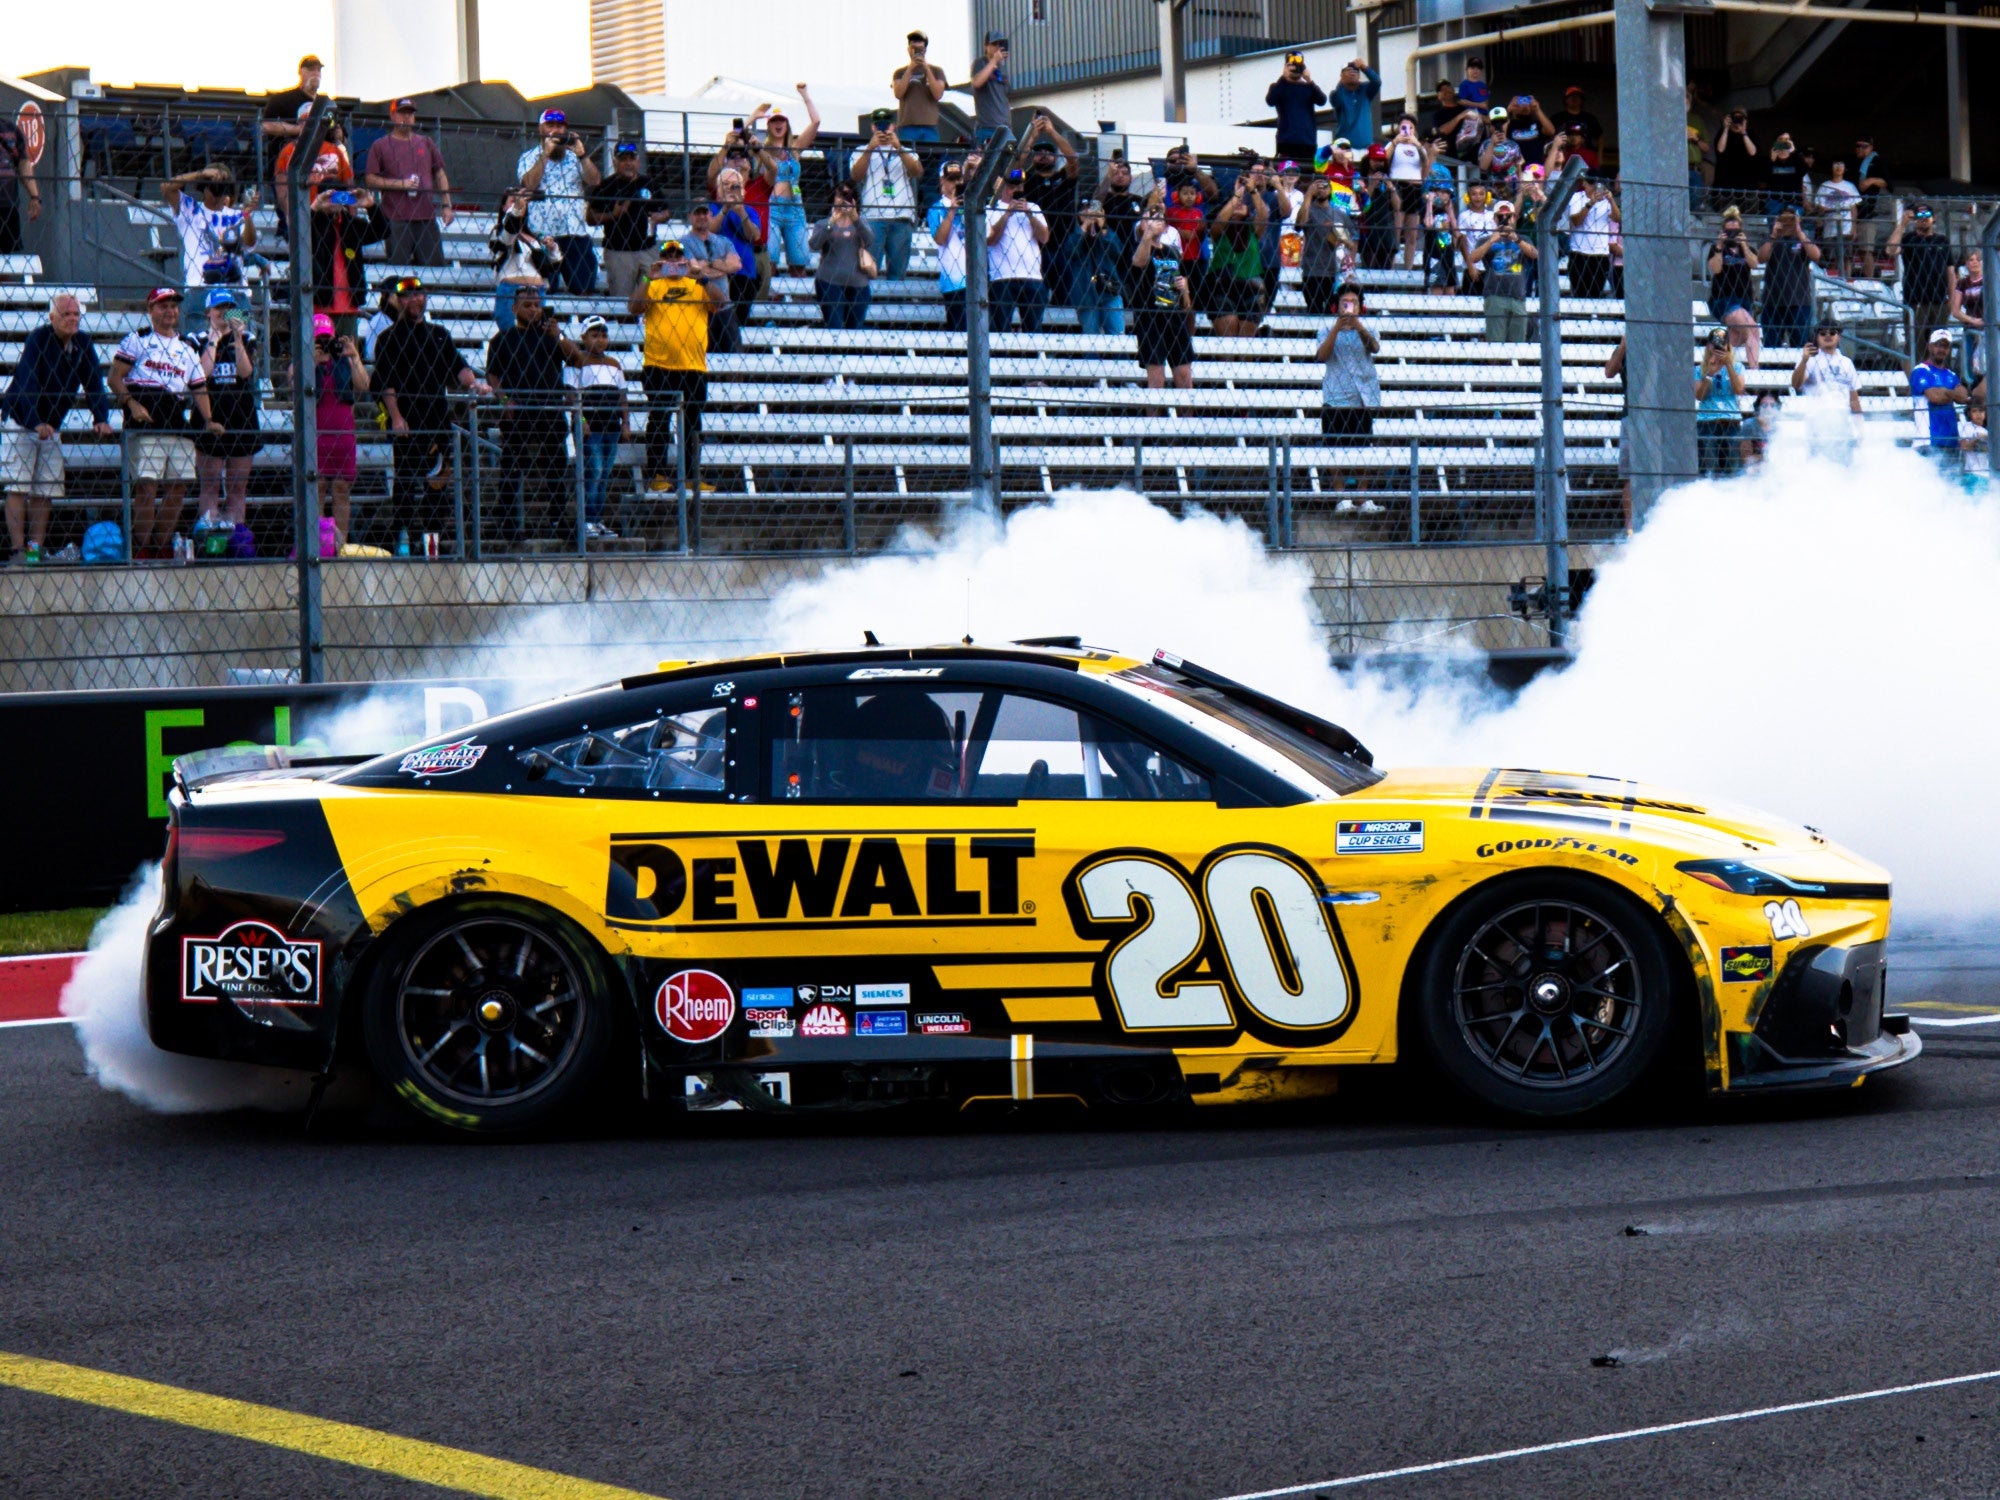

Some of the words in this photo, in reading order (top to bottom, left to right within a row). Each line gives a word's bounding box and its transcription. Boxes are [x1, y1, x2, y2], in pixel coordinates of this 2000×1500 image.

[403, 747, 482, 766] INTERSTATE
[406, 757, 473, 769] BATTERIES
[1364, 822, 1412, 833] NASCAR
[1348, 836, 1372, 847] CUP
[1372, 835, 1412, 846] SERIES
[1476, 837, 1639, 866] GOODYEAR
[1763, 898, 1811, 941] 20
[1068, 846, 1357, 1038] 20
[192, 945, 313, 993] RESER'S
[1725, 958, 1770, 971] SUNOCO
[221, 982, 245, 992] FINE
[247, 983, 282, 993] FOOS
[820, 985, 851, 997] DN
[862, 989, 904, 999] SIEMENS
[664, 972, 729, 1031] Rheem
[746, 1009, 787, 1021] Sport
[802, 1005, 847, 1027] MAC
[917, 1015, 960, 1024] LINCOLN
[760, 1019, 794, 1031] Clips
[802, 1026, 847, 1036] TOOLS
[926, 1024, 965, 1032] WELDERS
